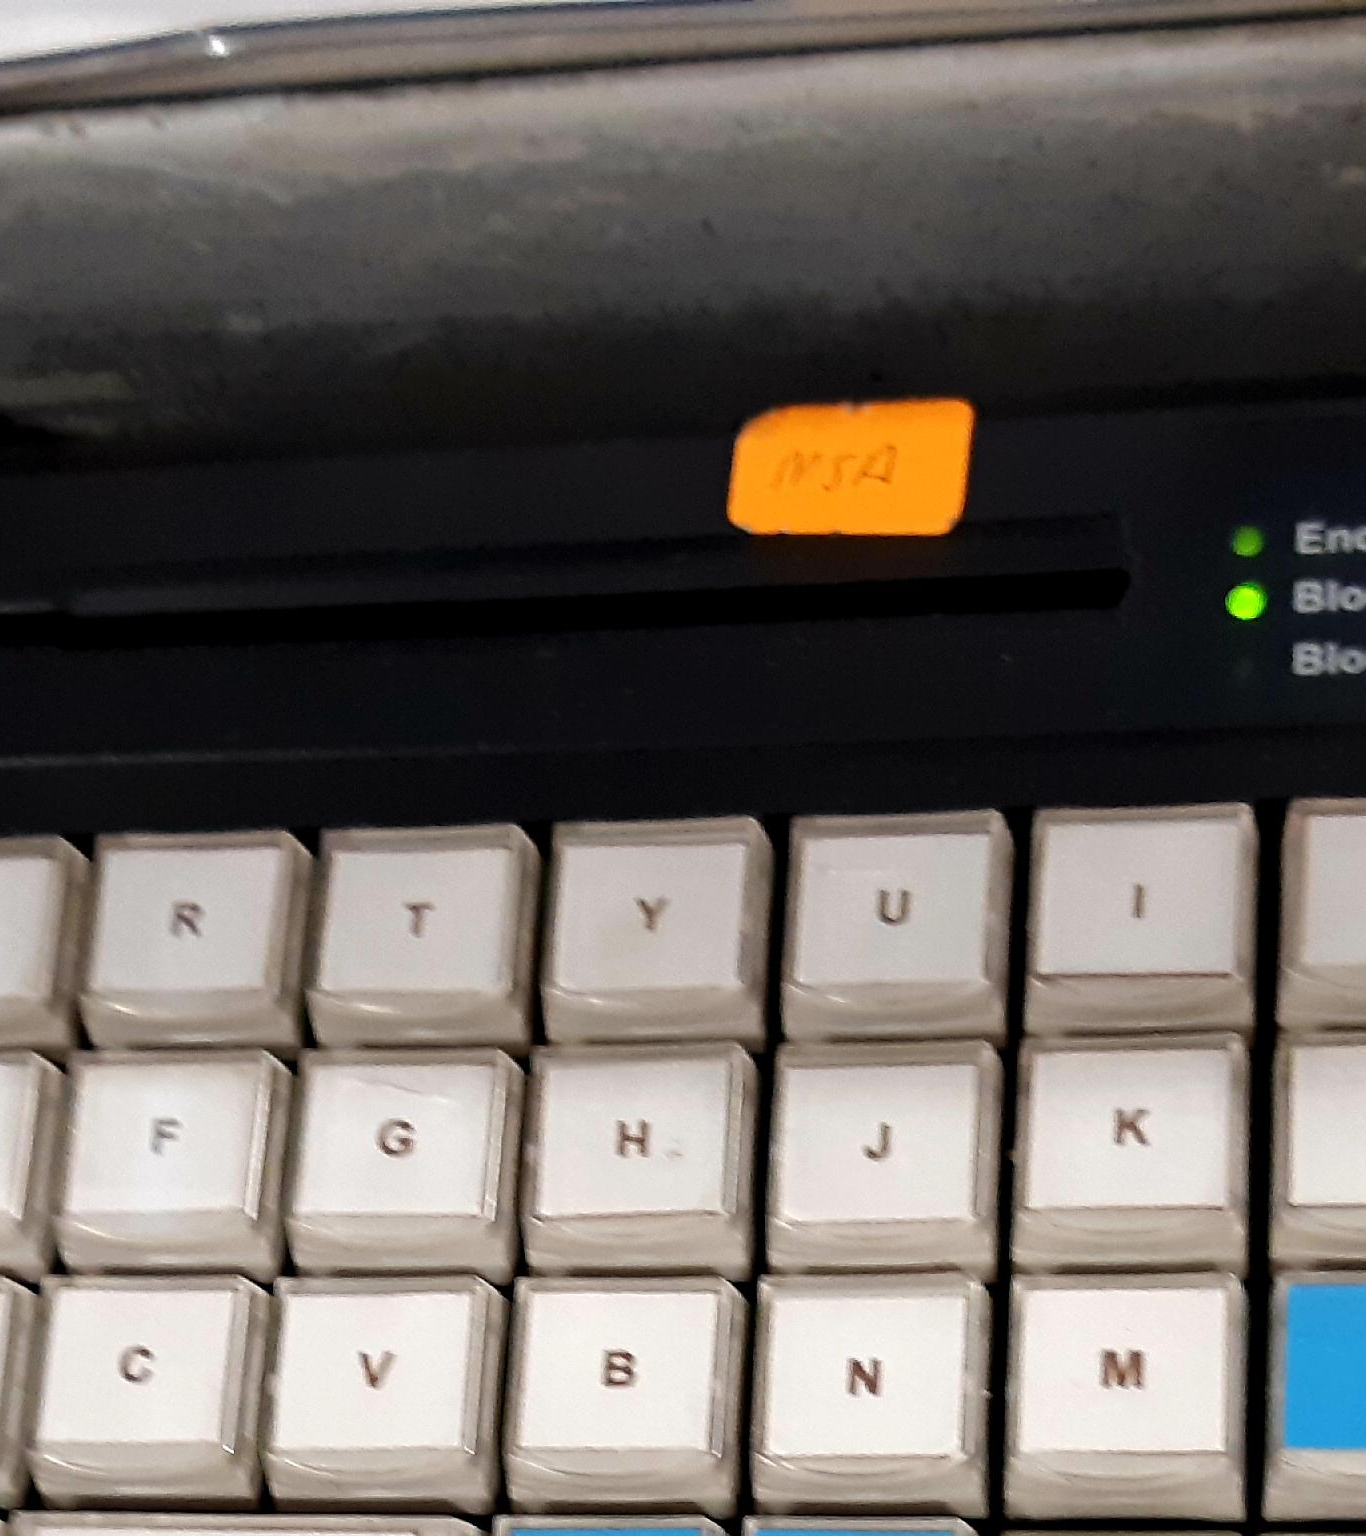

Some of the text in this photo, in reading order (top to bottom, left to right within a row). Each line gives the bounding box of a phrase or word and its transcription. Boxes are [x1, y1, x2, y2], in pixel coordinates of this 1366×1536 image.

[171, 902, 202, 935] R
[405, 902, 433, 937] T
[637, 899, 666, 931] Y
[877, 890, 911, 926] U
[151, 1118, 180, 1154] F
[378, 1120, 414, 1157] G
[617, 1121, 650, 1157] H
[864, 1123, 891, 1161] J
[1114, 1109, 1148, 1145] K
[120, 1346, 153, 1383] C
[359, 1352, 394, 1389] V
[603, 1351, 635, 1387] B
[848, 1359, 880, 1395] N
[1102, 1350, 1144, 1388] M
